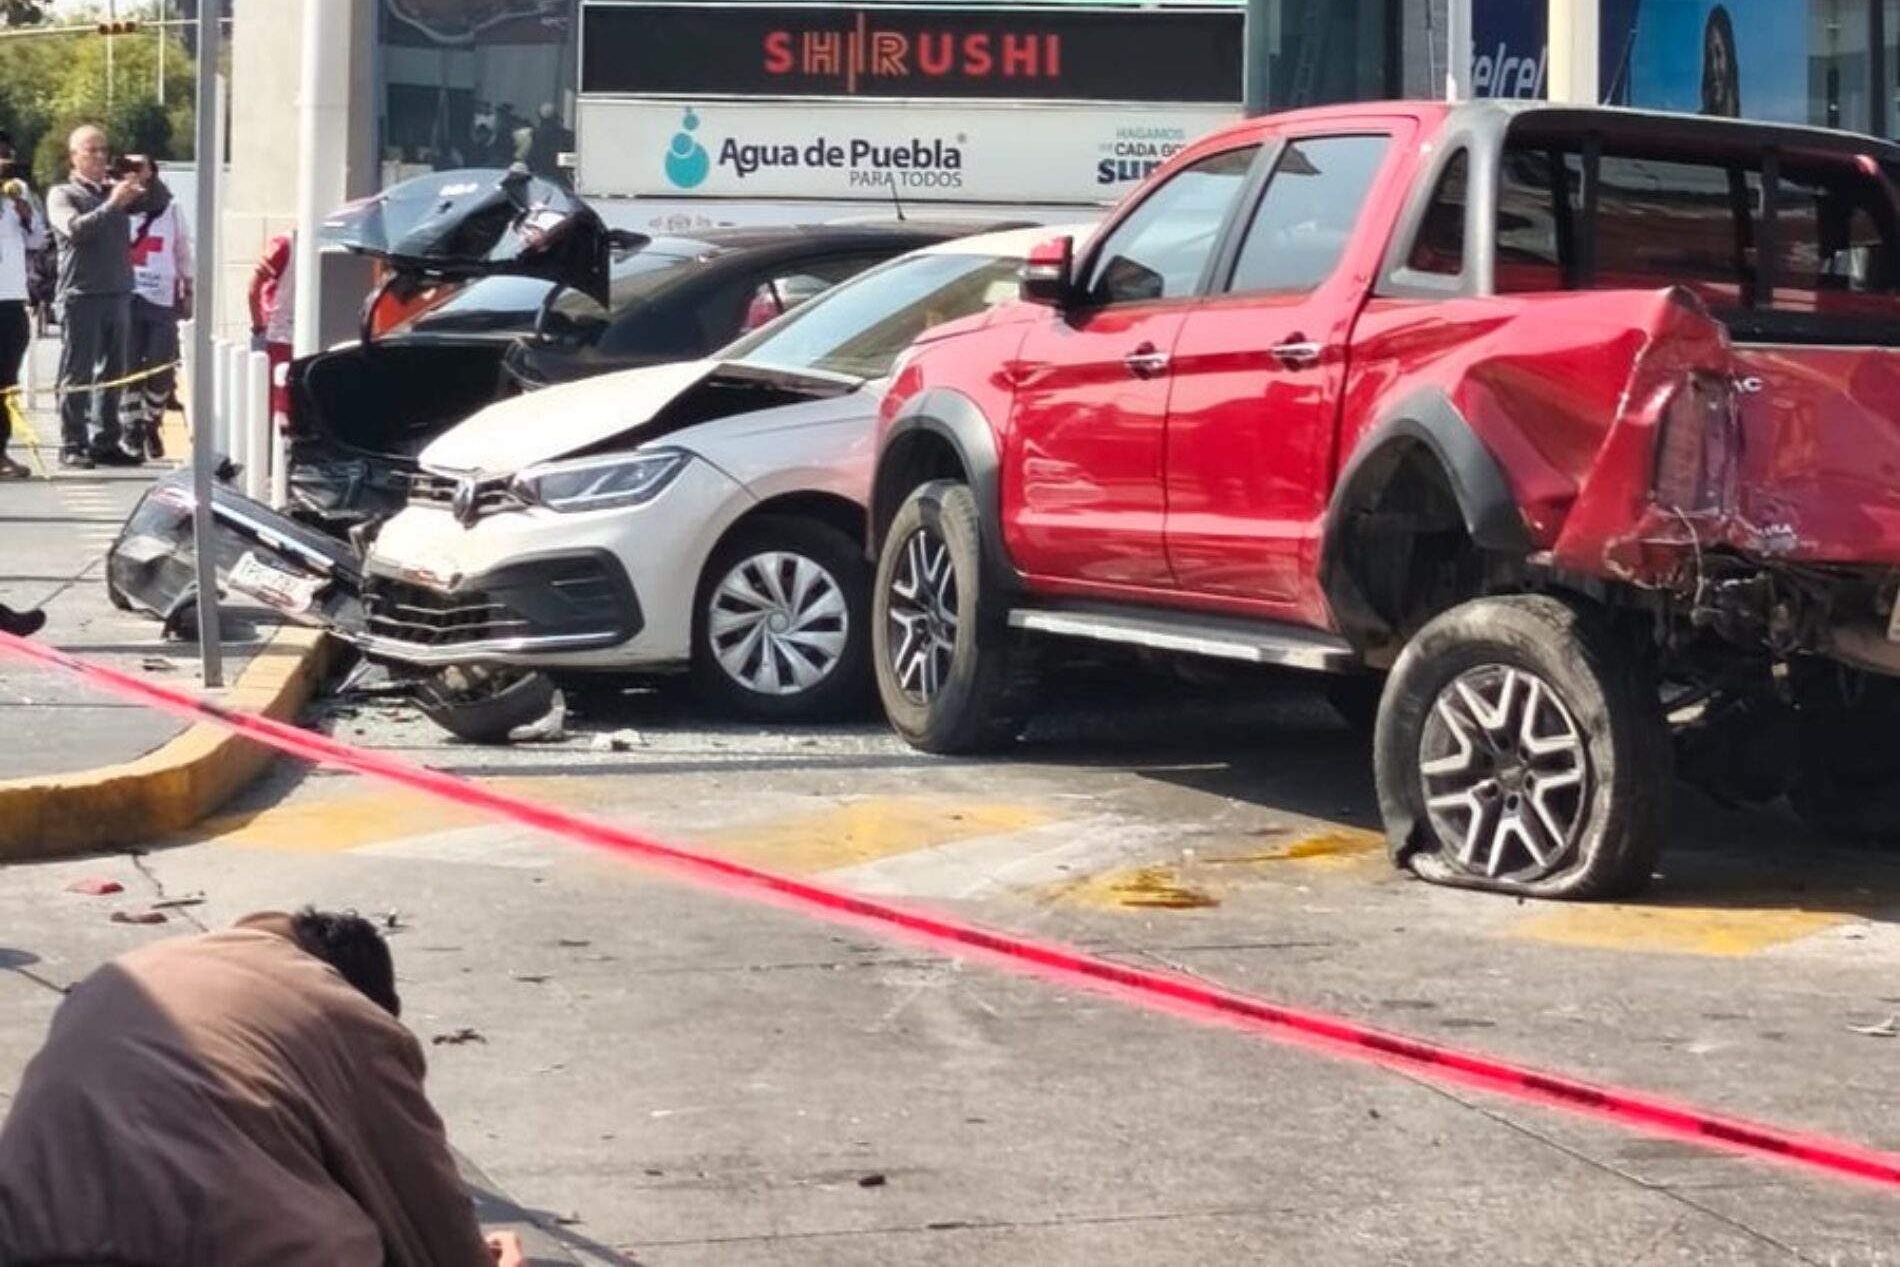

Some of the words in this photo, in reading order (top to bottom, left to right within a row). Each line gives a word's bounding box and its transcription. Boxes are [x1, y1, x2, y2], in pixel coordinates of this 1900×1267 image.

[764, 12, 1060, 94] SHIRUSHI
[1471, 42, 1547, 99] elcel
[718, 138, 798, 178] Agua
[804, 137, 844, 167] de
[851, 139, 962, 168] Puebla
[1115, 143, 1157, 156] CADA
[850, 171, 894, 187] PARA
[900, 171, 962, 187] TODOS
